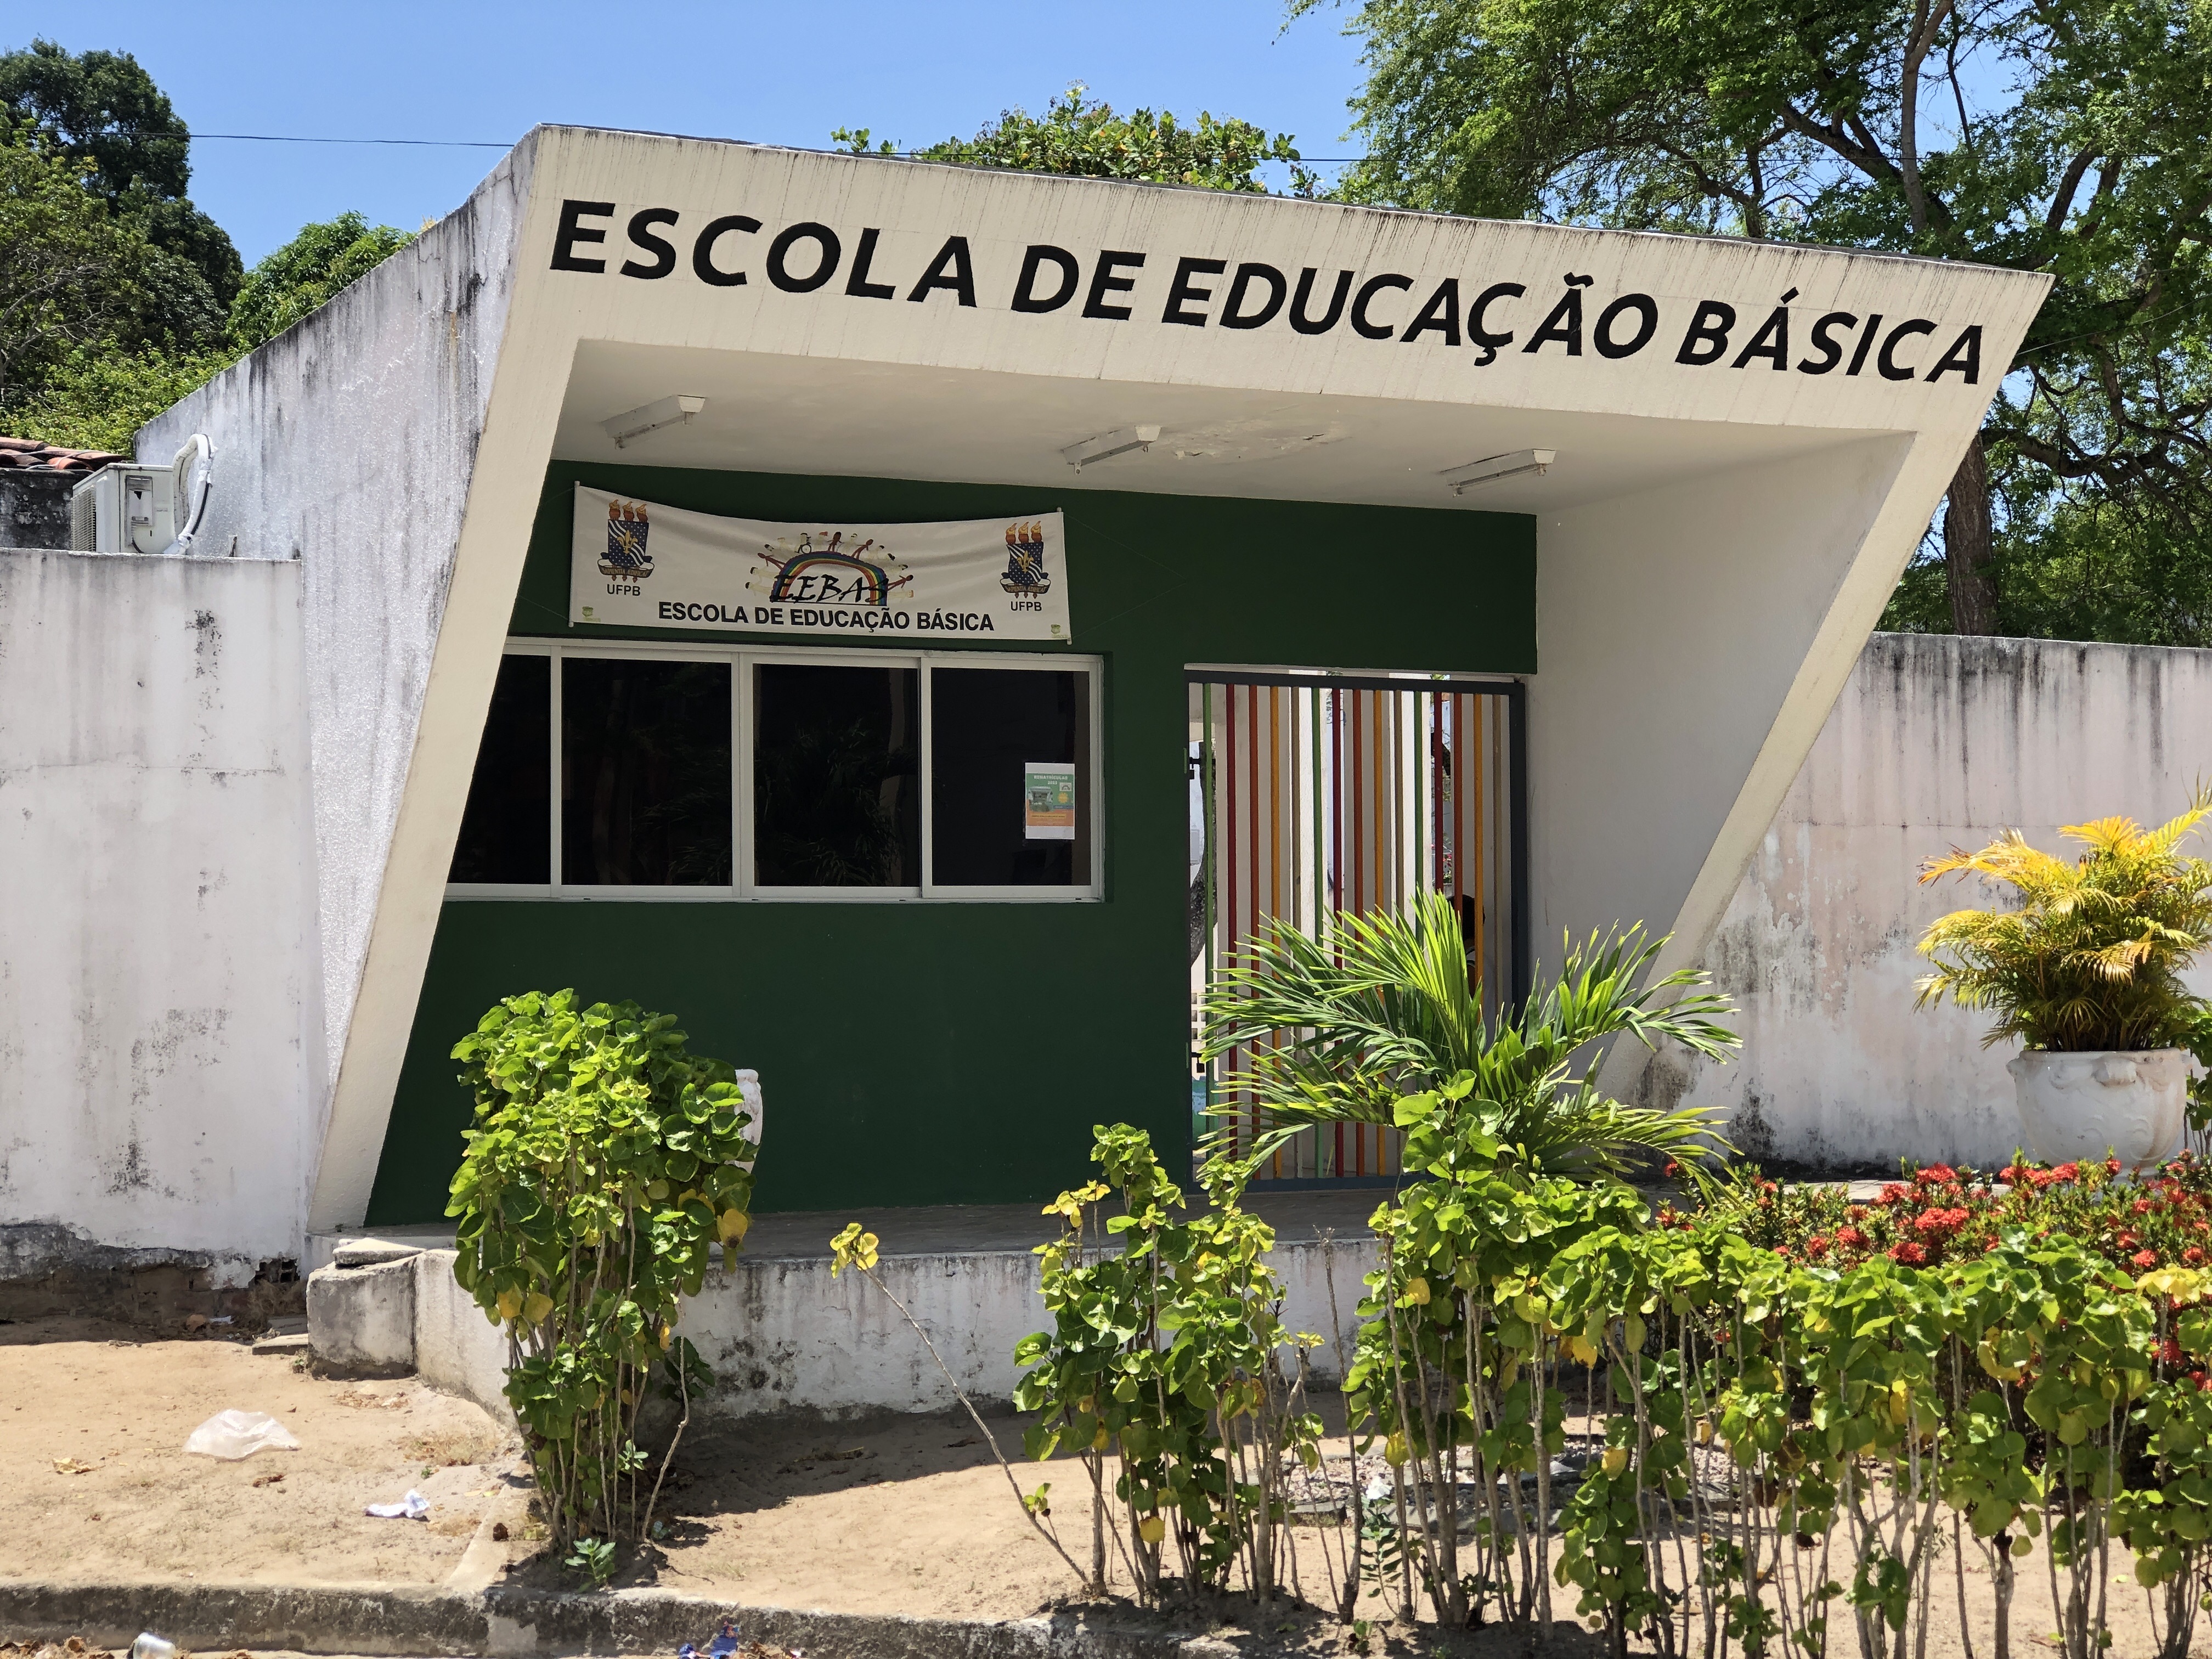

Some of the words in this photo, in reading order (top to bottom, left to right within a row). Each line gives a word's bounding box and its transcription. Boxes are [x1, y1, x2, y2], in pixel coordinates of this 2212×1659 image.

[550, 199, 977, 307] ESCOLA
[1011, 245, 1146, 320] DE
[1162, 257, 1658, 366] EDUCAÇÃO
[1675, 286, 1982, 384] BÁSICA
[607, 584, 641, 596] UFPB
[769, 574, 889, 603] EEBAS
[658, 601, 749, 623] ESCOLA
[754, 607, 784, 625] DE
[790, 607, 910, 633] EDUCAÇÃO
[917, 608, 995, 631] BÁSICA
[1011, 601, 1042, 611] UFPB
